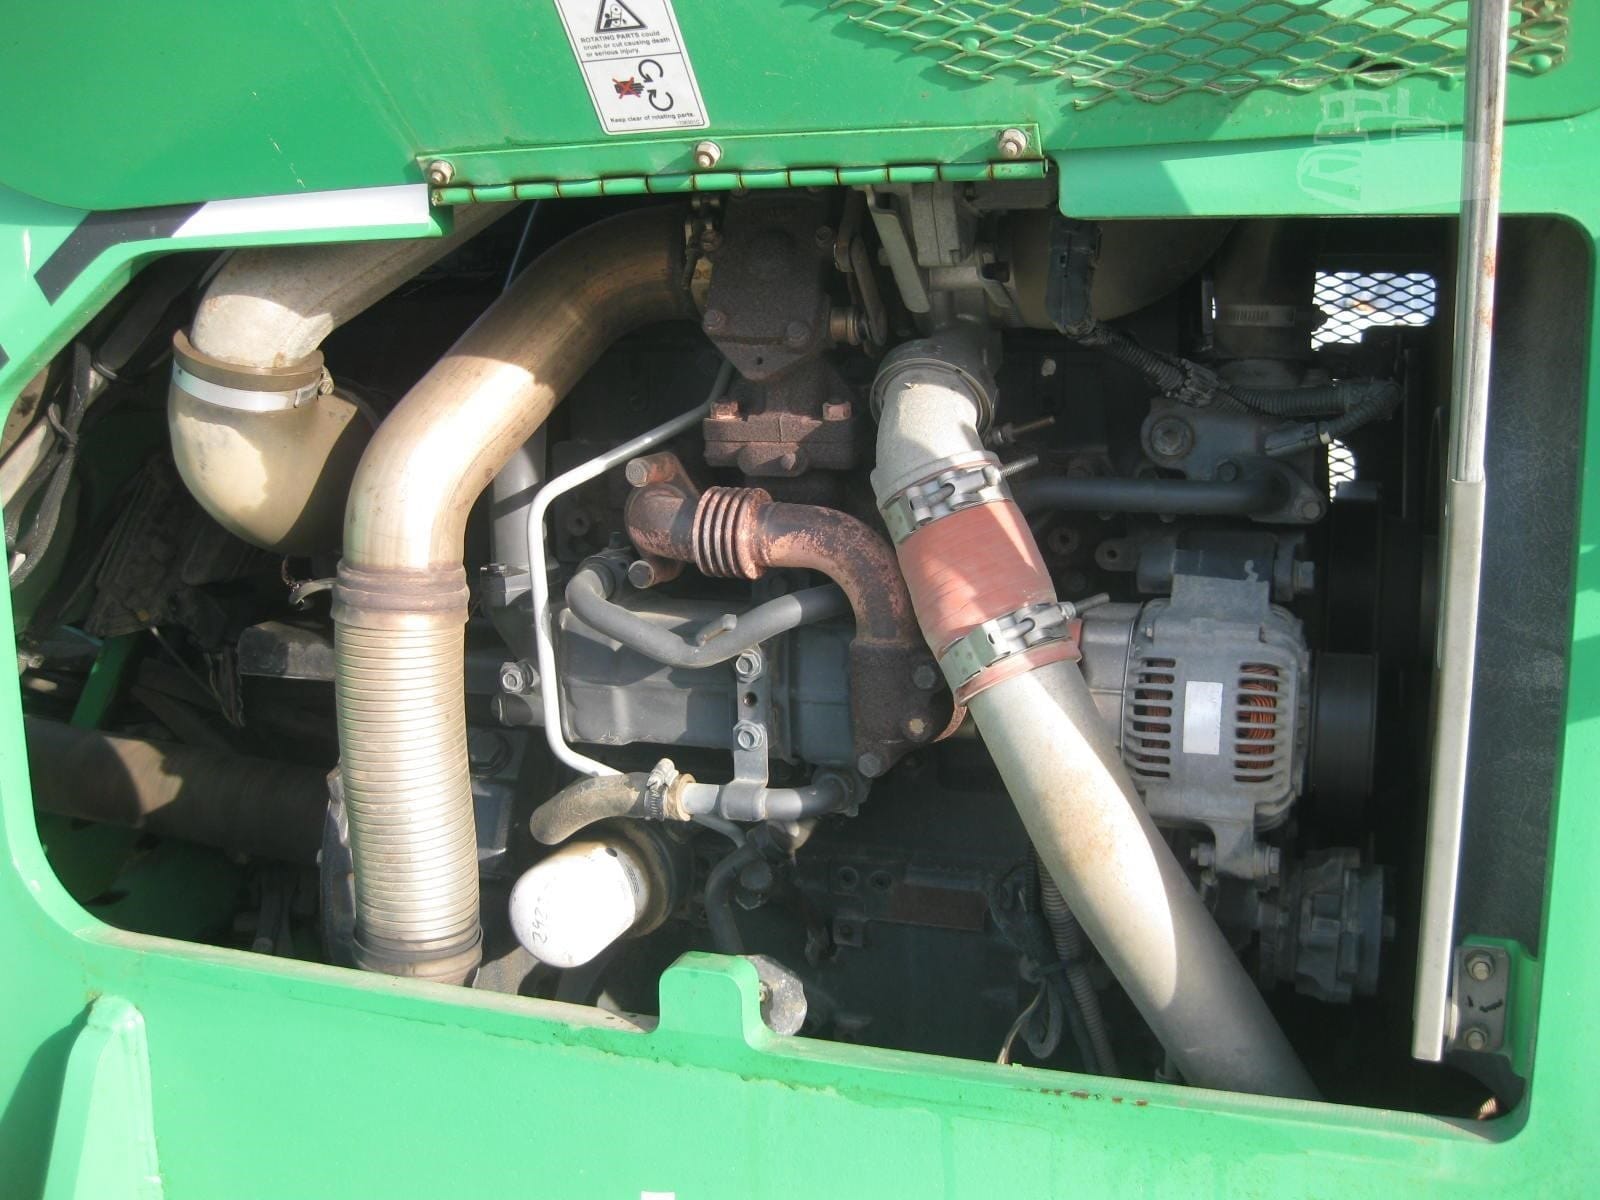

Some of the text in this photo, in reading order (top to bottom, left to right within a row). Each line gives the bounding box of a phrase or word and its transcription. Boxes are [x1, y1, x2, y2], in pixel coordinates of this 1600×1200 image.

[580, 34, 615, 43] ROTATING
[616, 31, 640, 39] PARTS
[624, 39, 651, 47] causing
[651, 36, 671, 44] death
[651, 113, 676, 121] rotating
